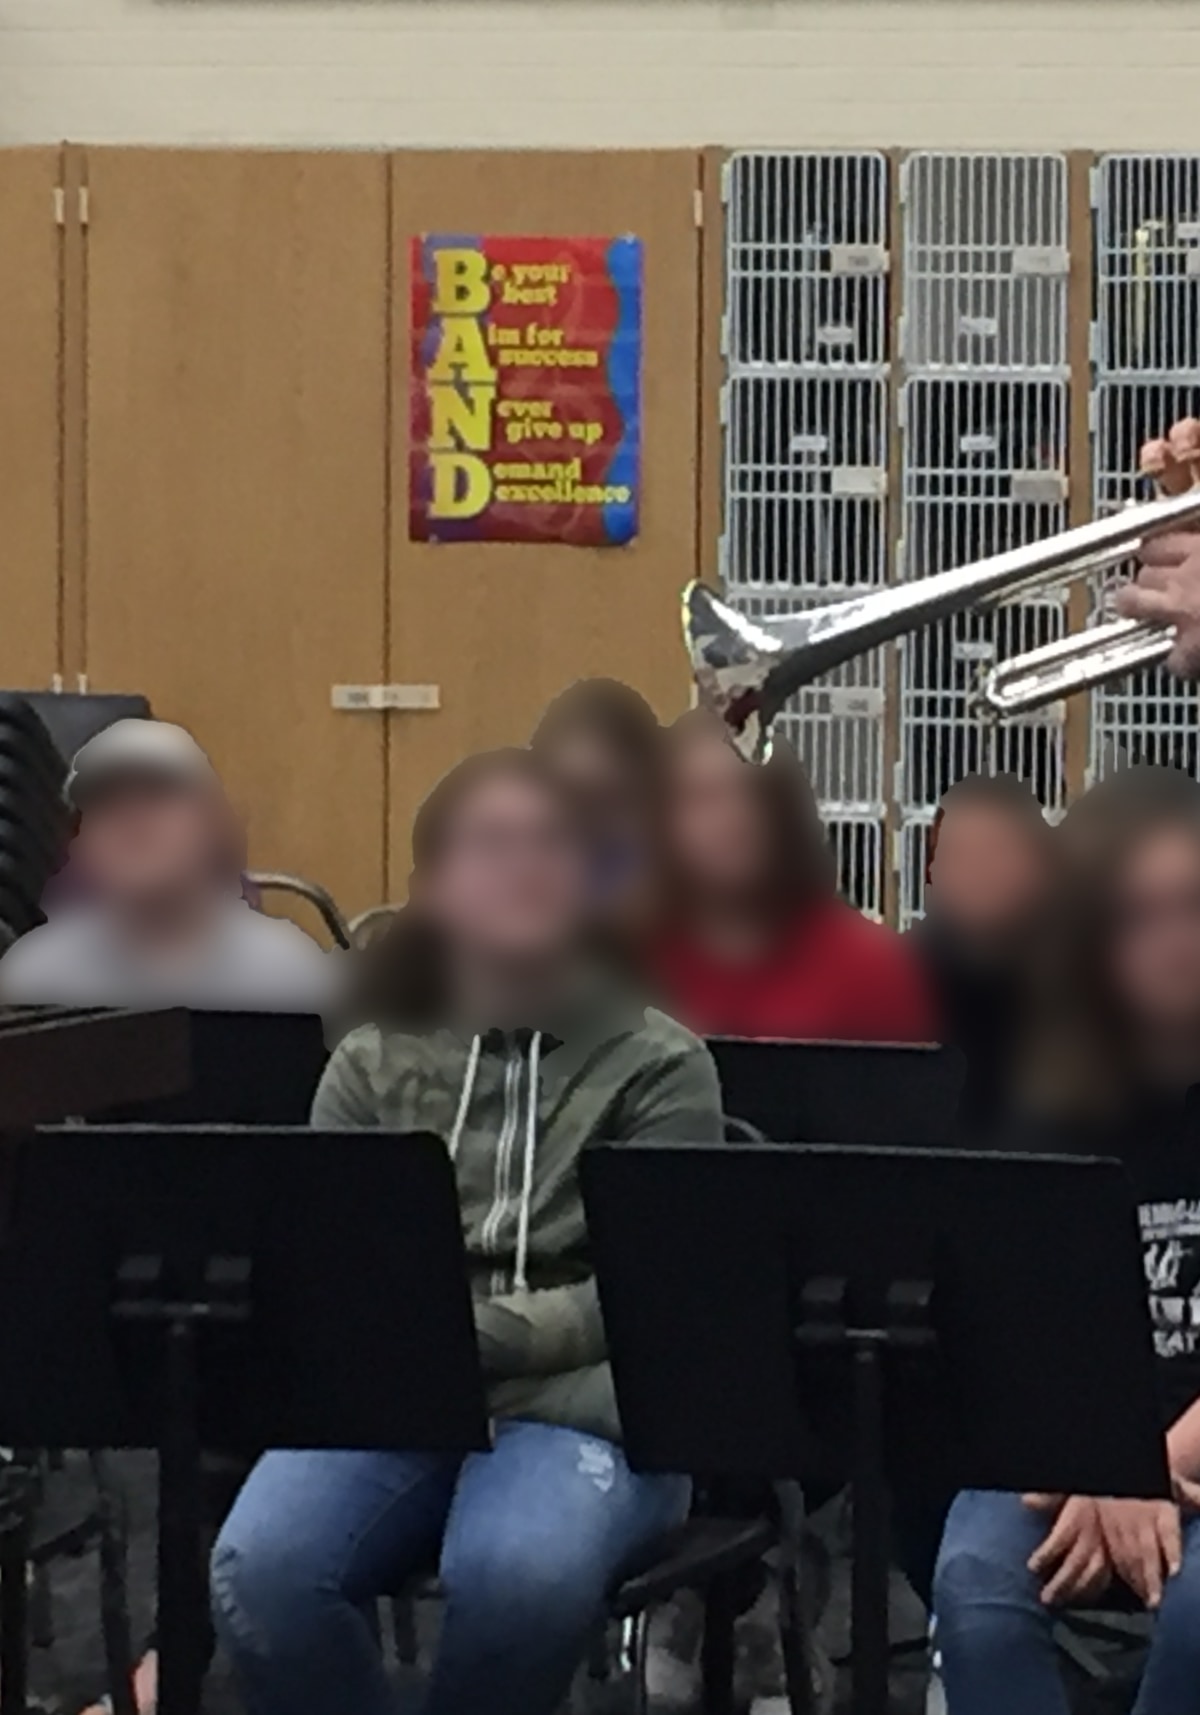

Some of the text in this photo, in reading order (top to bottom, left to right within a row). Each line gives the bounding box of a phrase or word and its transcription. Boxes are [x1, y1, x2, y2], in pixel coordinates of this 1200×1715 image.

[511, 265, 571, 285] your
[503, 284, 558, 304] best
[527, 322, 562, 345] for
[499, 349, 597, 367] success
[506, 418, 603, 445] give up
[496, 482, 630, 503] excellence
